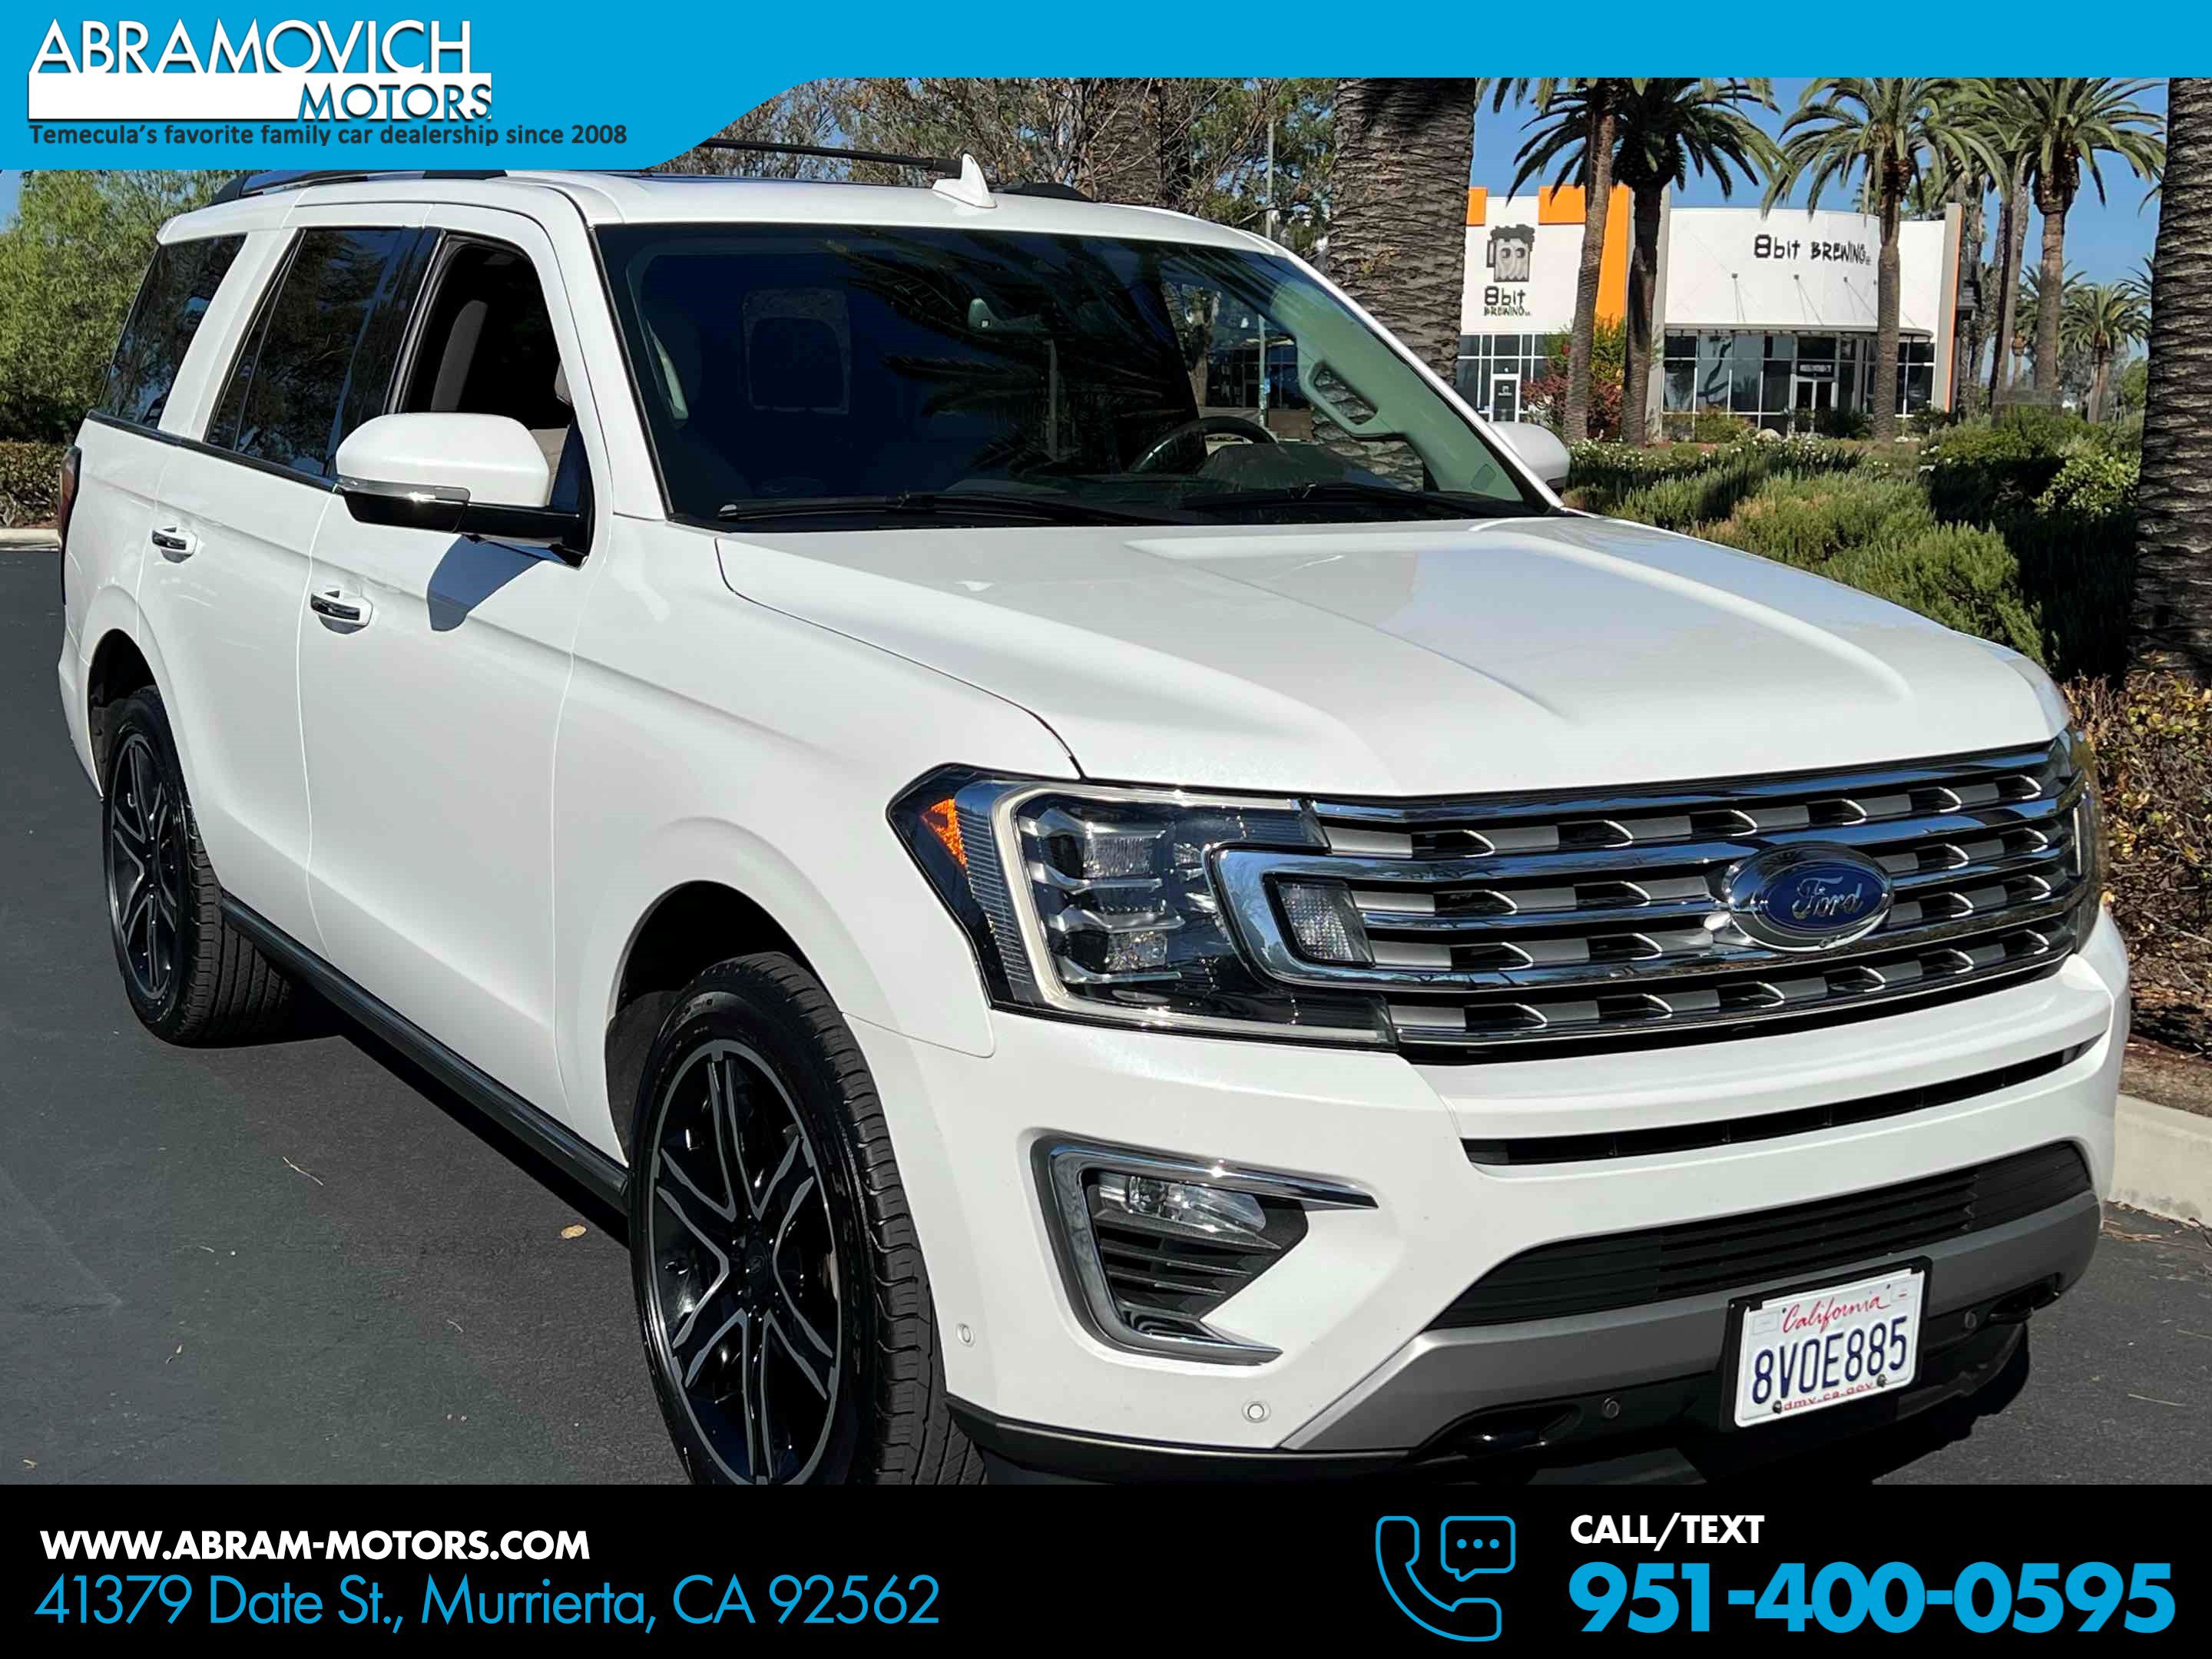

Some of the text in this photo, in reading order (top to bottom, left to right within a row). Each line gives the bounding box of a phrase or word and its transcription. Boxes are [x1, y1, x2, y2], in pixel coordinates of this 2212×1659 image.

[1754, 233, 1866, 264] 8bit BREWING
[1484, 285, 1526, 306] 8bit
[1791, 876, 1864, 919] Ford
[1781, 1294, 1892, 1335] California
